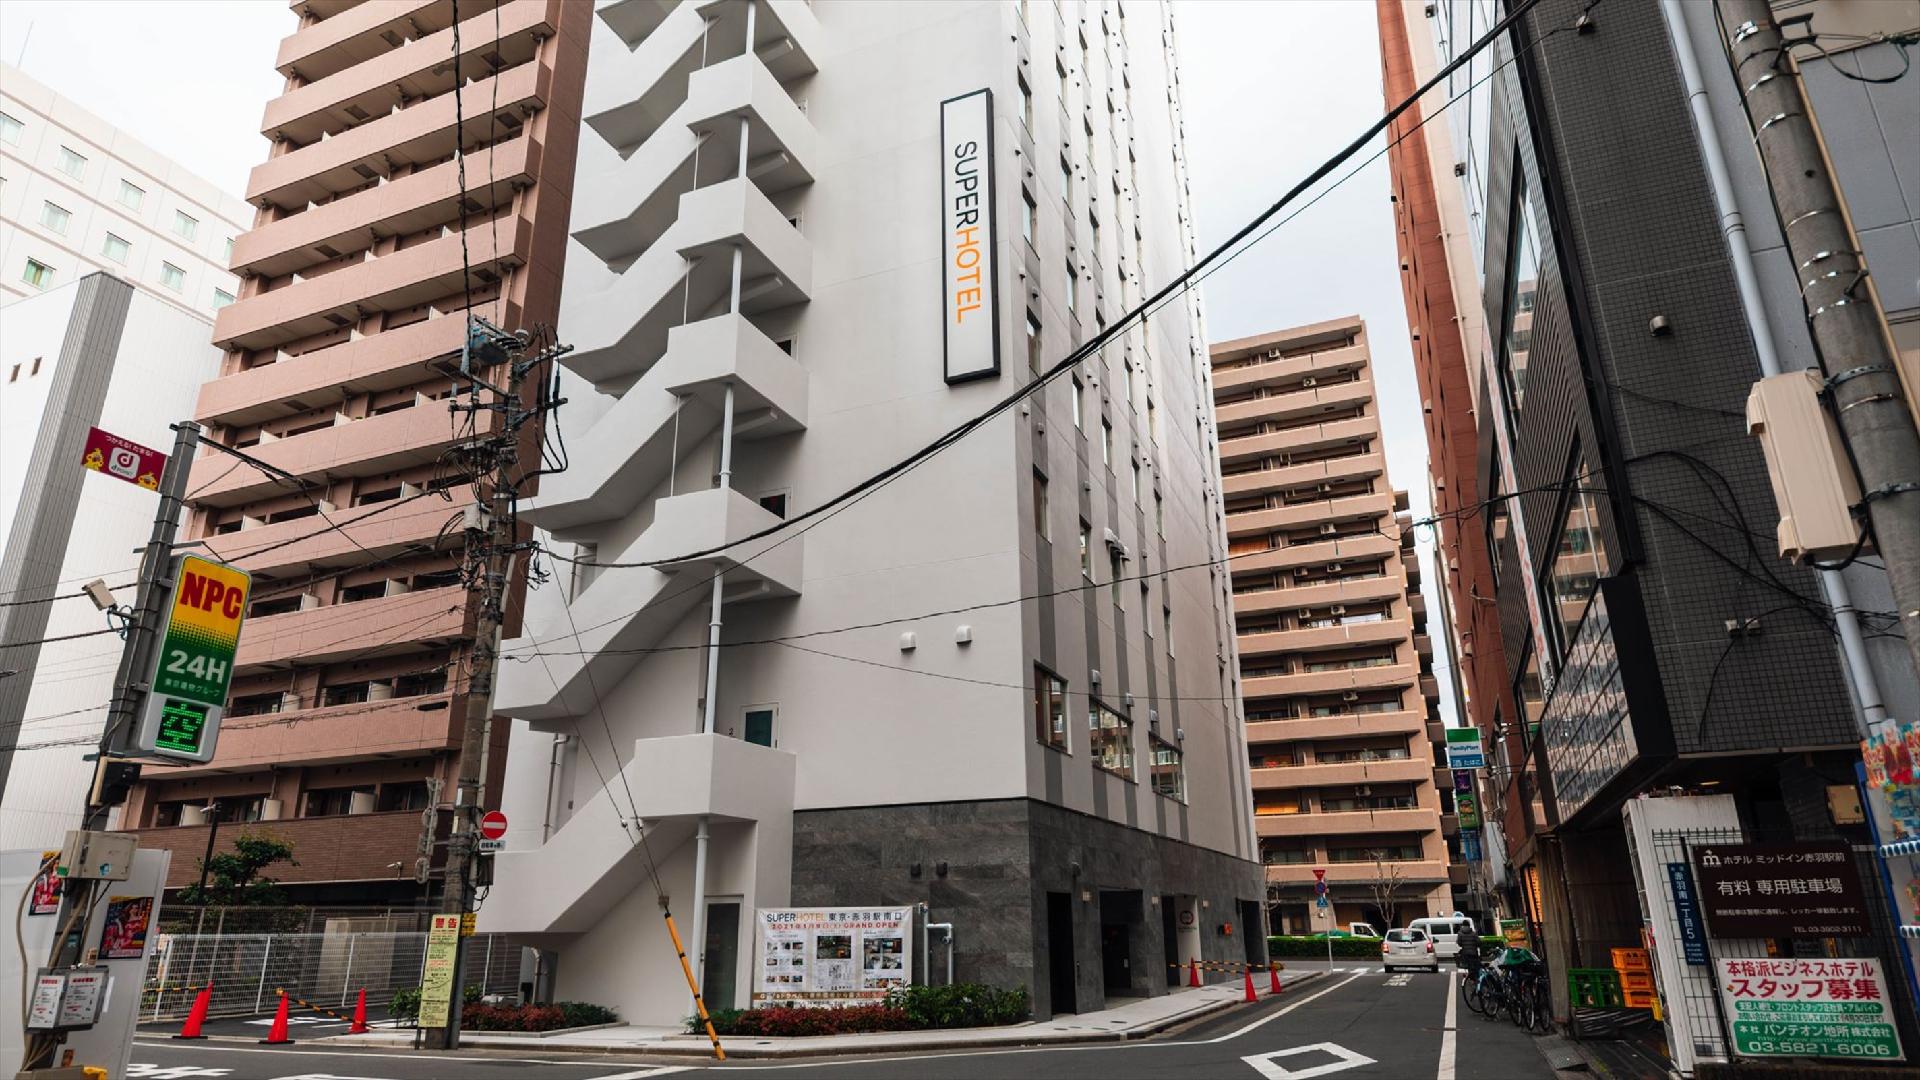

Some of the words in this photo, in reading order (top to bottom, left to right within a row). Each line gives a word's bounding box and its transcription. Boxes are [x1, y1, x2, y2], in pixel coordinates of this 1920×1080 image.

[954, 140, 982, 325] SUPERHOTEL
[180, 570, 244, 620] NPC
[166, 649, 228, 685] 24H
[1723, 855, 1753, 865] ホテル
[1716, 879, 1752, 897] 有料
[1756, 877, 1844, 896] 専用駐車場
[766, 912, 825, 923] SUPERHOTEL
[1793, 926, 1807, 934] TEL
[1726, 960, 1874, 977] 本格派ビジネスホテル
[1731, 978, 1881, 1000] スタッフ募集
[1739, 1025, 1760, 1034] 本社
[1764, 1025, 1850, 1038] パンテオン地所
[1850, 1027, 1892, 1038] 株式会社
[1748, 1041, 1891, 1055] 03-5821-6006
